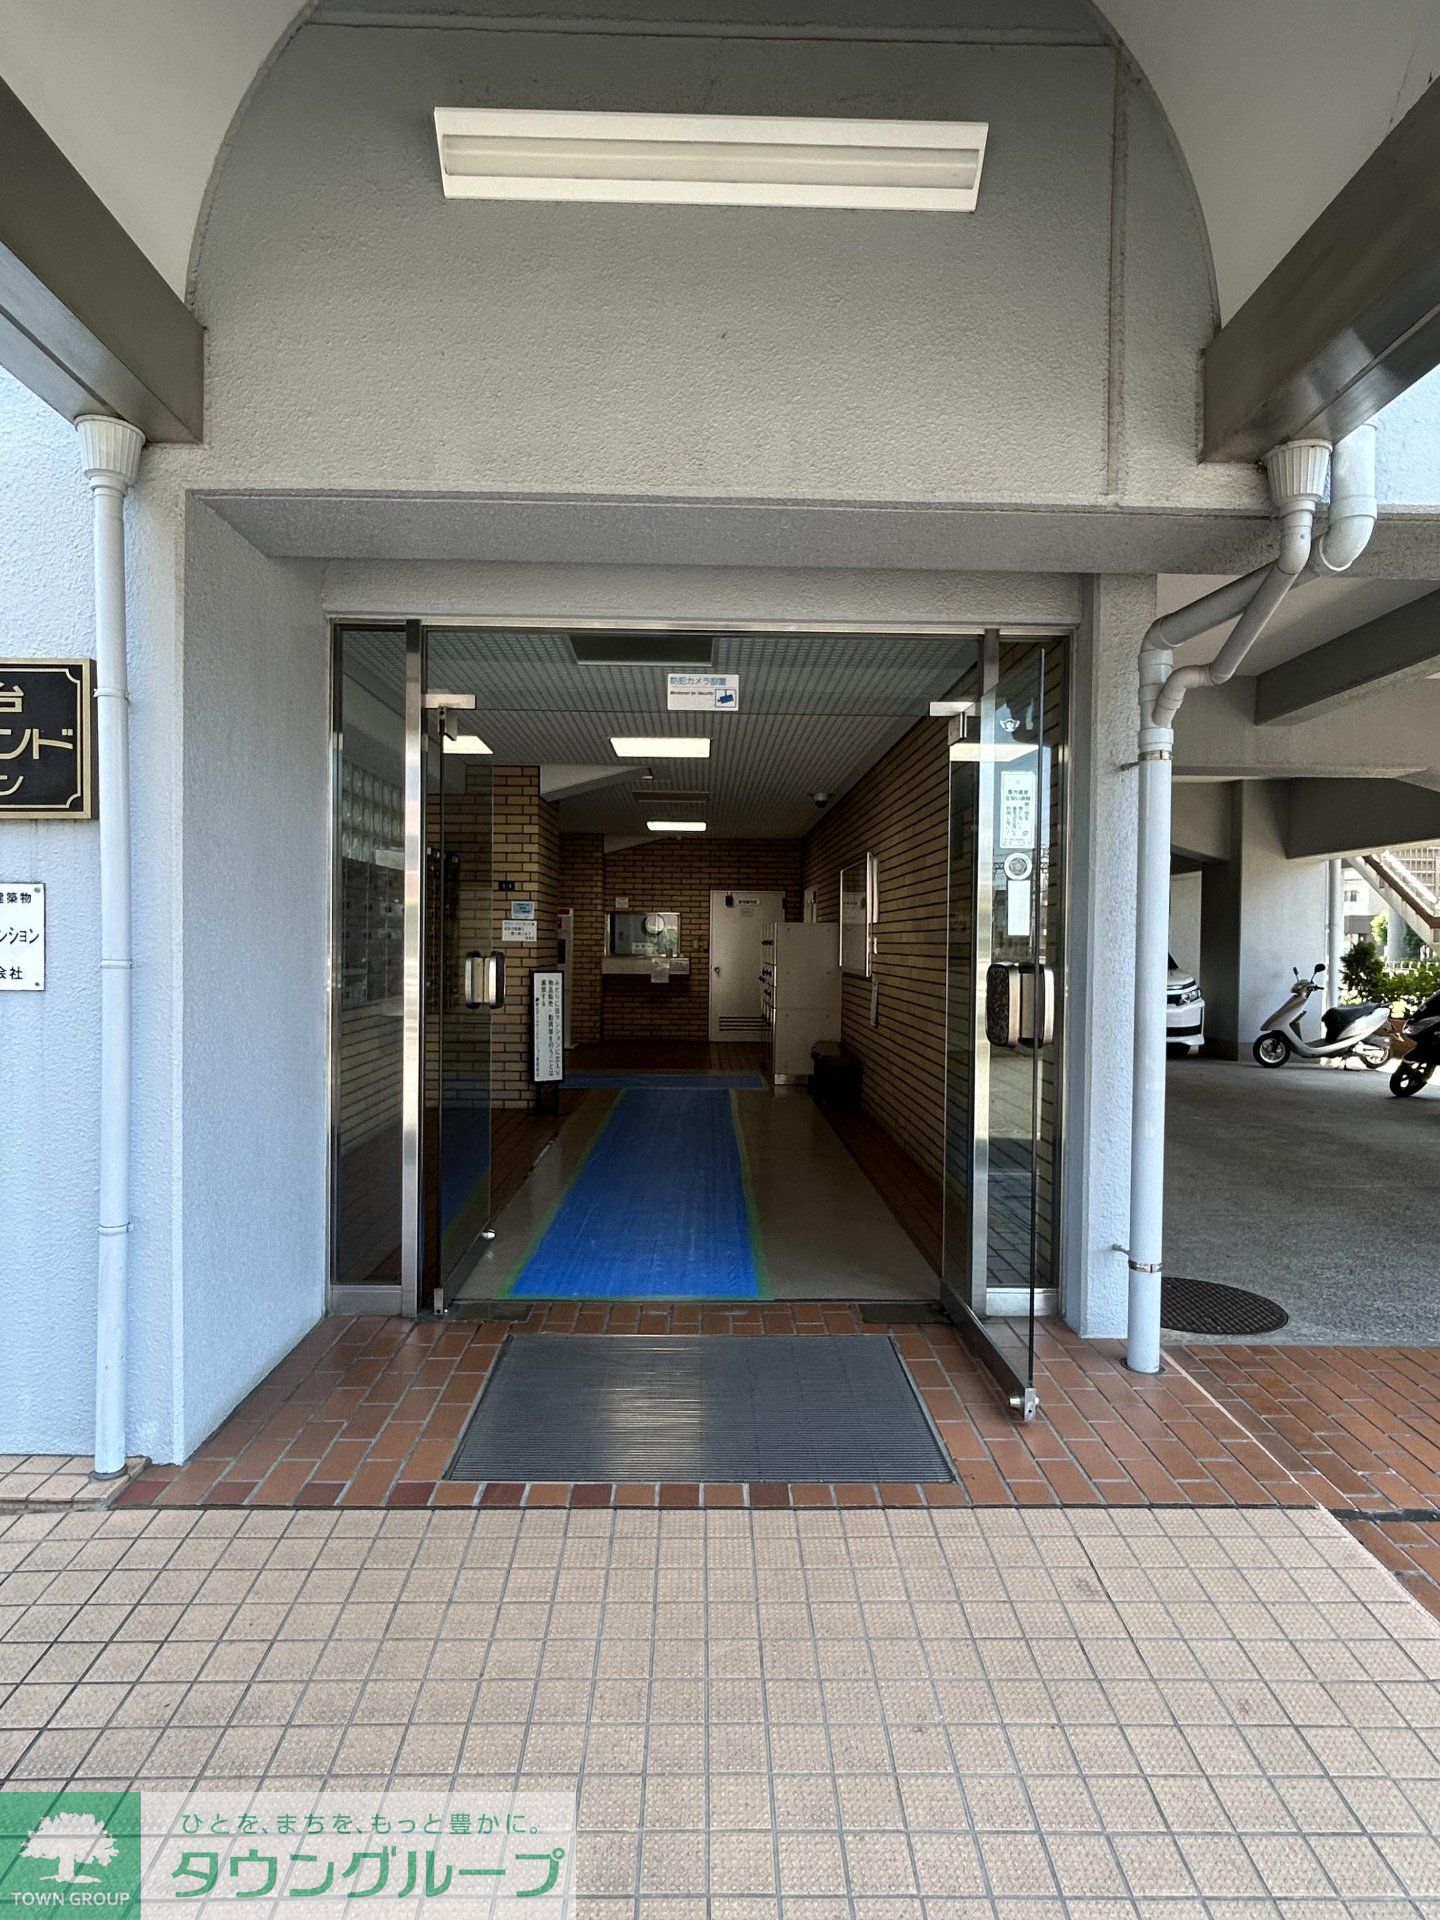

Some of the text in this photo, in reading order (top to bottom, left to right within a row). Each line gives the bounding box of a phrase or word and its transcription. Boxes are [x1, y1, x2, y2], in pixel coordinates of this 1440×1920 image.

[670, 676, 727, 685] 防犯カメラ設置
